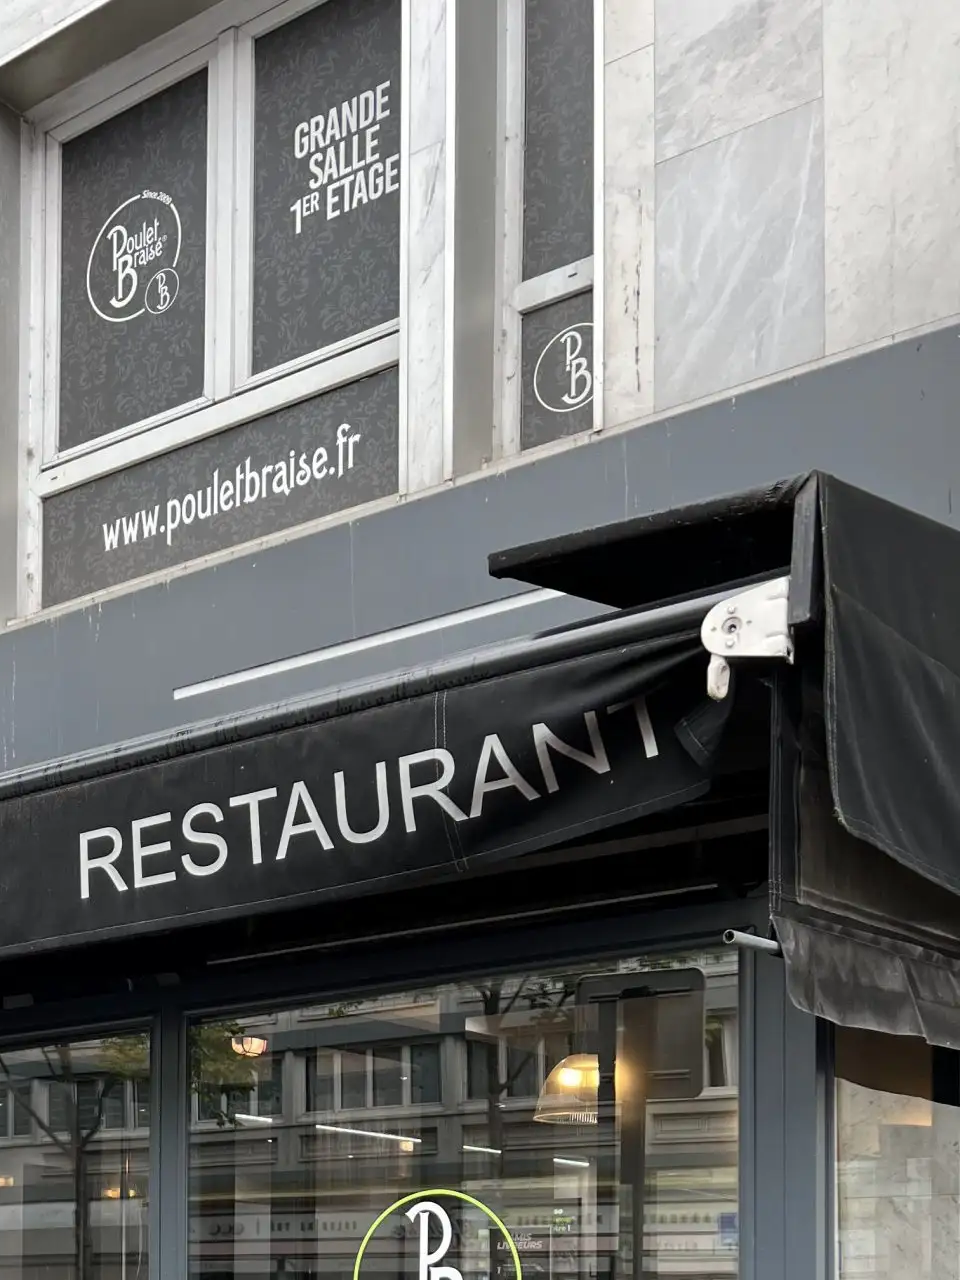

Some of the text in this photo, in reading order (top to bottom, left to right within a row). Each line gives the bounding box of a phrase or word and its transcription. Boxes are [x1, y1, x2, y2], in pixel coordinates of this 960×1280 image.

[294, 80, 390, 159] GRANDE
[308, 124, 380, 190] SALLE
[290, 153, 399, 234] 1ER ETAGE
[106, 217, 160, 272] Poulet
[156, 272, 170, 310] PB
[560, 331, 593, 404] PB
[102, 423, 360, 551] www.pouletbraise.fr
[79, 697, 660, 900] RESTAURANT
